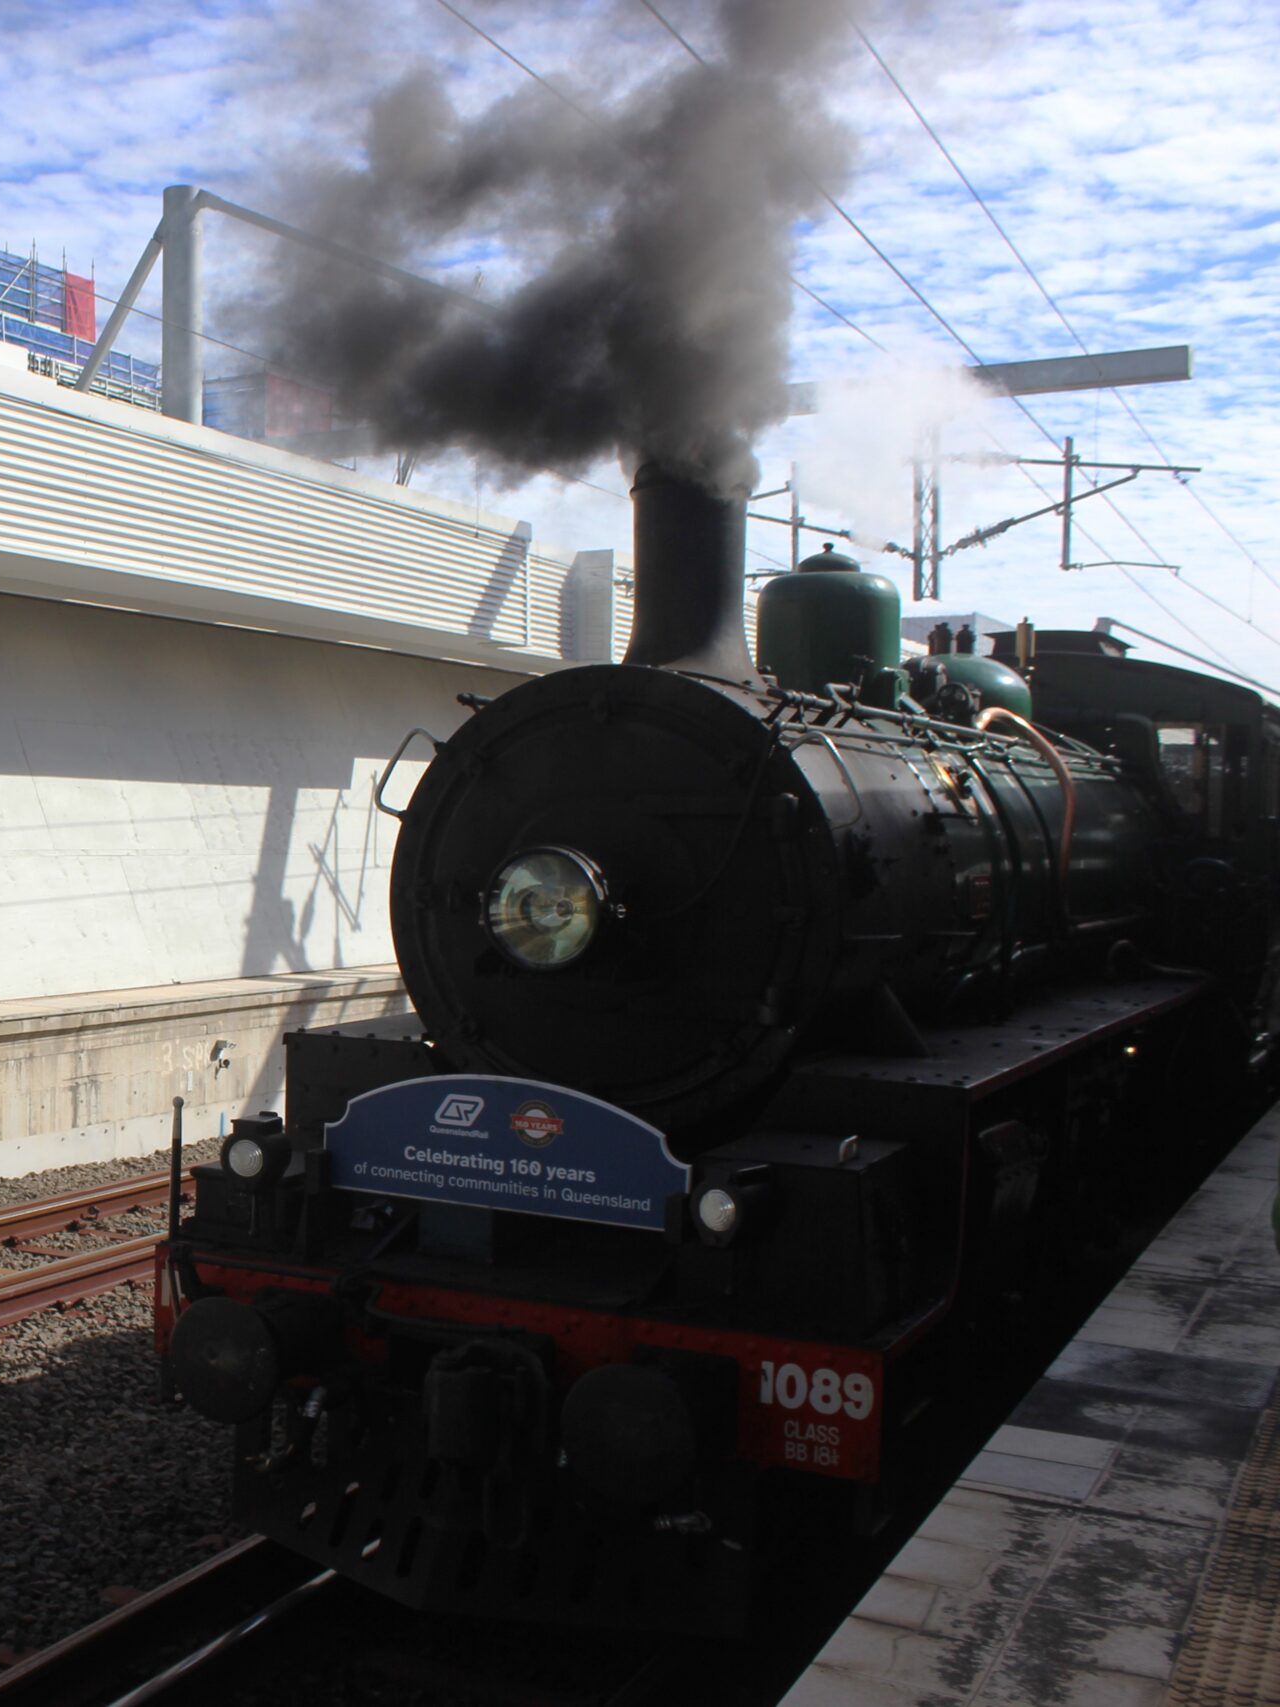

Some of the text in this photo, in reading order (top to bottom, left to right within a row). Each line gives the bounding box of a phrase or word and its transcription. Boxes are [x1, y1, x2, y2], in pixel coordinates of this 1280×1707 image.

[531, 1121, 558, 1132] YEARS
[403, 1145, 596, 1183] Celebrating 160 years
[354, 1161, 651, 1212] of connecting communities in Queensland
[760, 1360, 875, 1421] 1089
[784, 1420, 840, 1446] CLASS
[785, 1441, 808, 1461] BB
